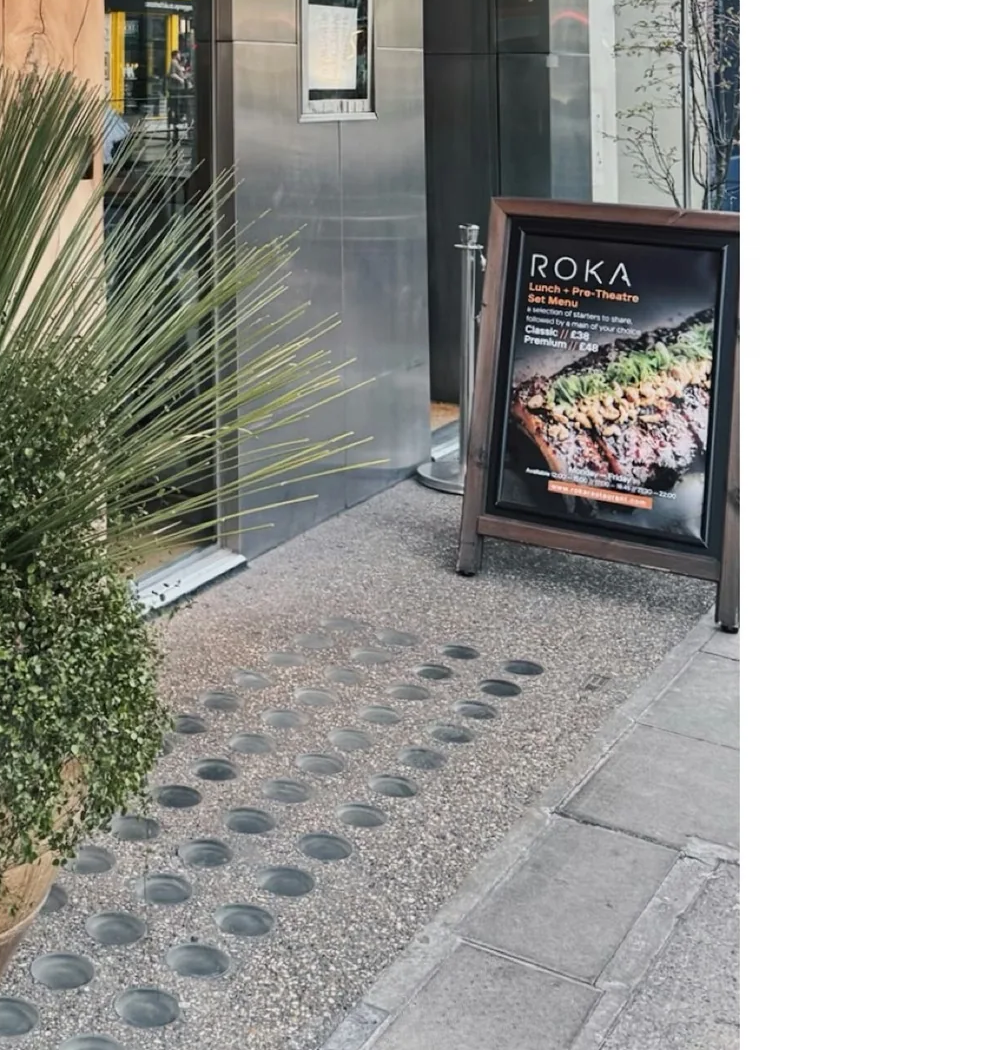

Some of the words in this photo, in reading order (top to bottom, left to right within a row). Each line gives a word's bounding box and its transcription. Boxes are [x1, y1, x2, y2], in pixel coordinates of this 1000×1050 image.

[530, 253, 632, 287] ROKA
[529, 282, 561, 294] Lunch
[572, 286, 640, 303] Pre-Theatre
[528, 294, 546, 304] Set
[548, 296, 579, 308] Menu
[526, 315, 555, 325] followed
[555, 317, 565, 327] by
[532, 306, 564, 316] selection
[573, 311, 601, 321] starters
[525, 325, 558, 337] Classic
[570, 330, 590, 341] £38
[524, 335, 568, 349] Premium
